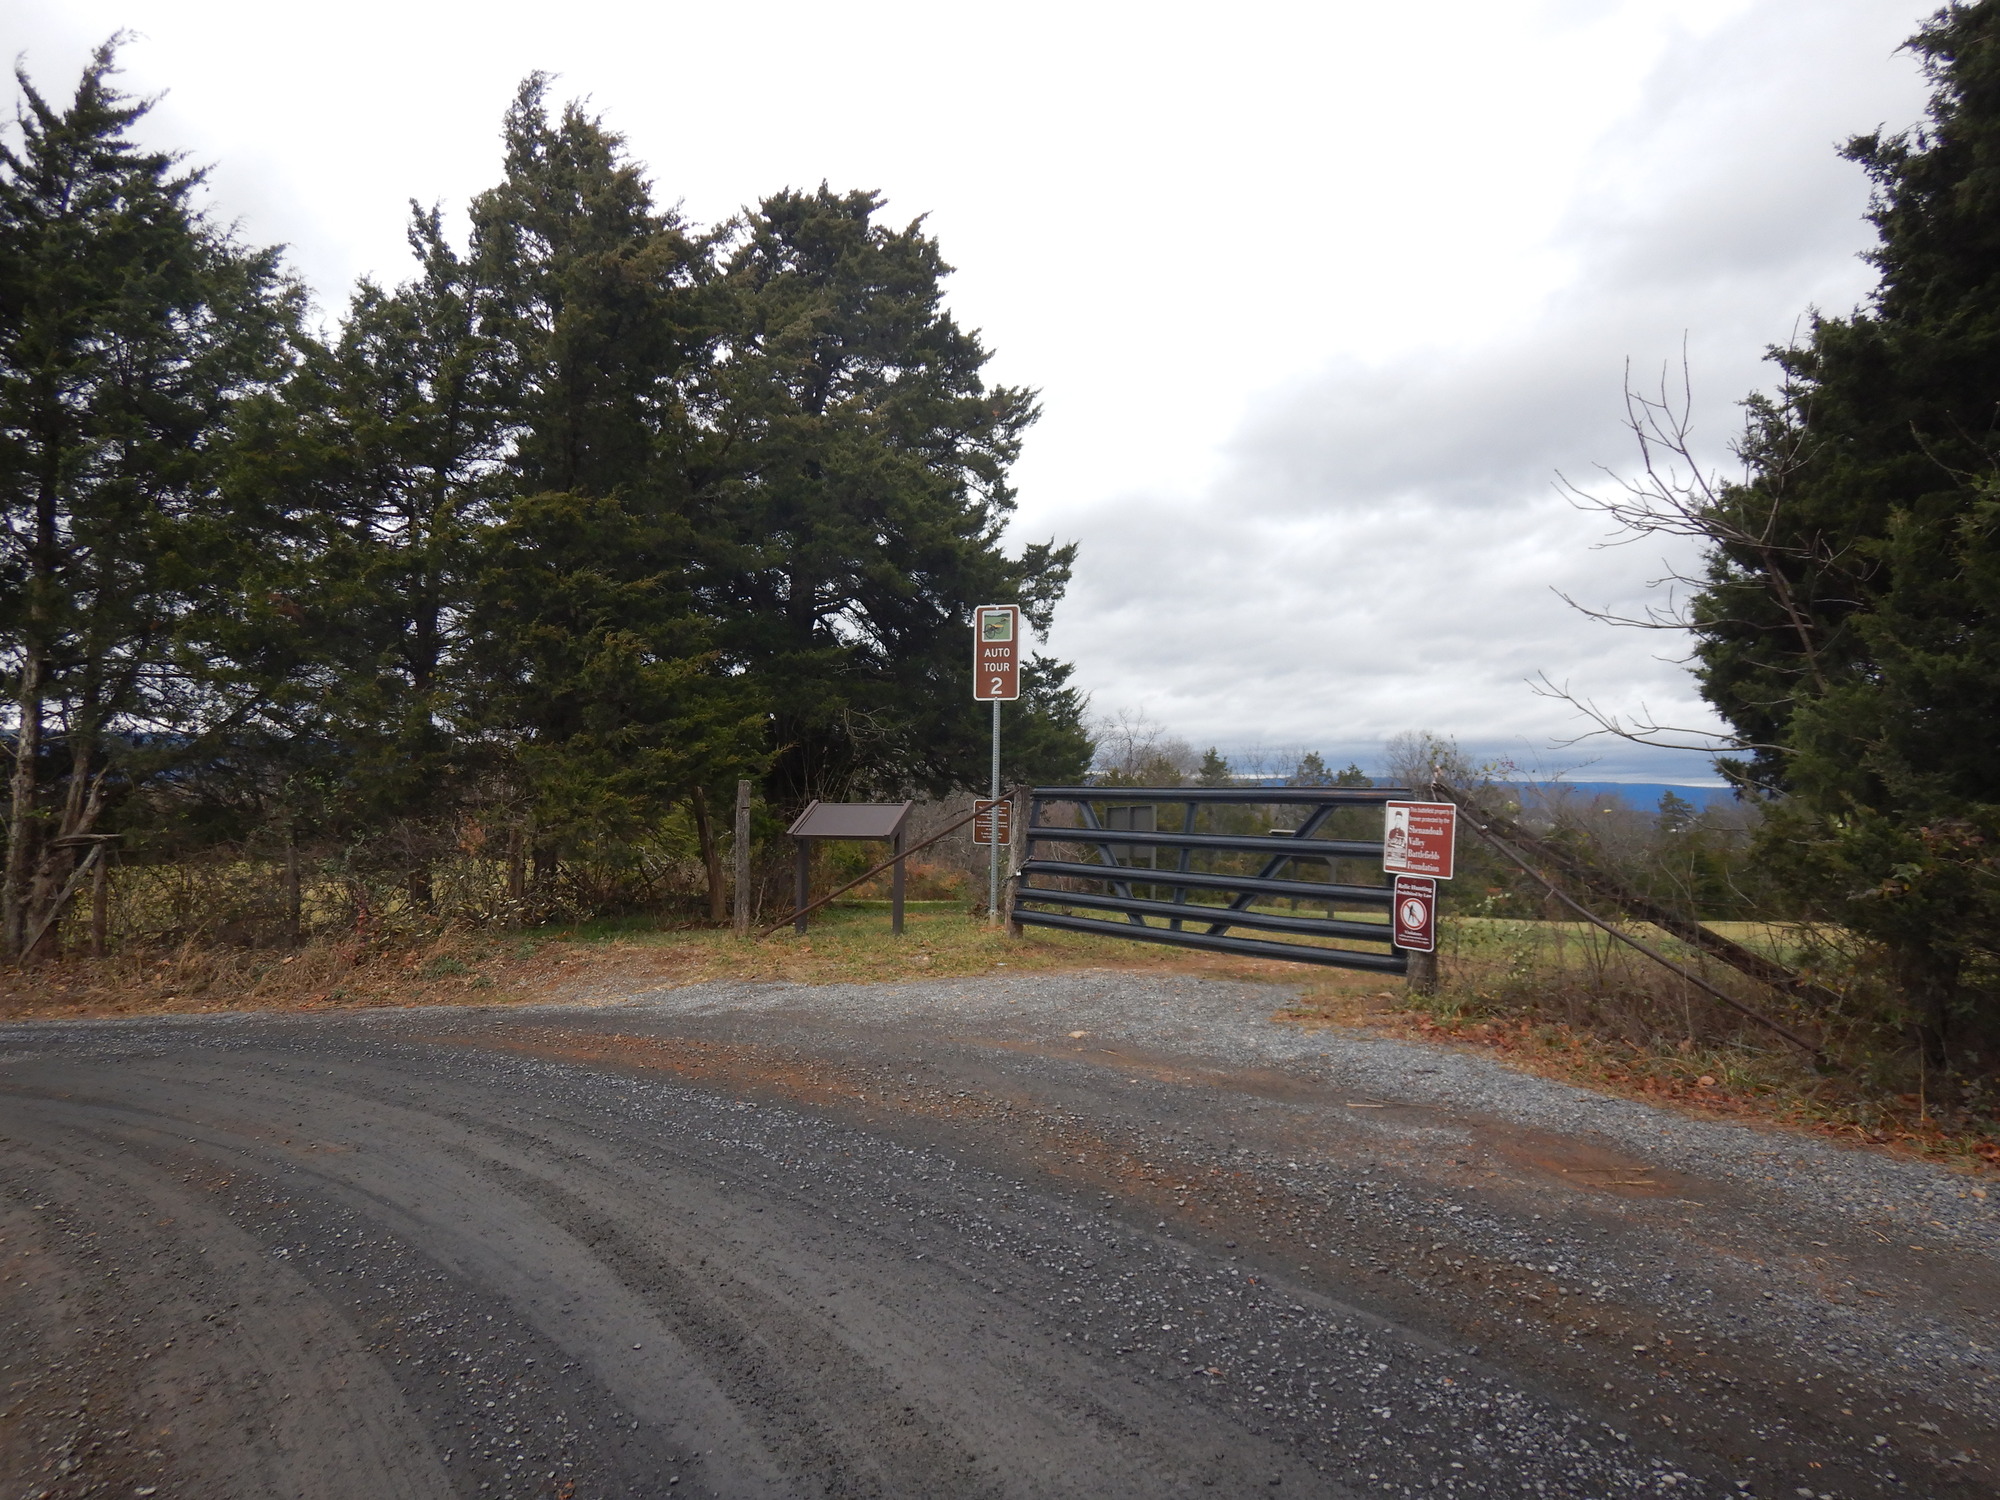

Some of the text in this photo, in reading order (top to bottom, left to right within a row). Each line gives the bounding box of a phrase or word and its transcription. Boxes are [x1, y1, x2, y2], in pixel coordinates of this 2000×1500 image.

[984, 648, 1011, 658] AUTO
[984, 662, 1010, 672] TOUR
[990, 676, 1003, 695] 2
[1408, 825, 1443, 836] Shenandoah
[1408, 836, 1426, 849] Valley
[1407, 848, 1440, 860] Battlefields
[1407, 860, 1440, 872] Foundation
[1411, 884, 1433, 893] Hunting
